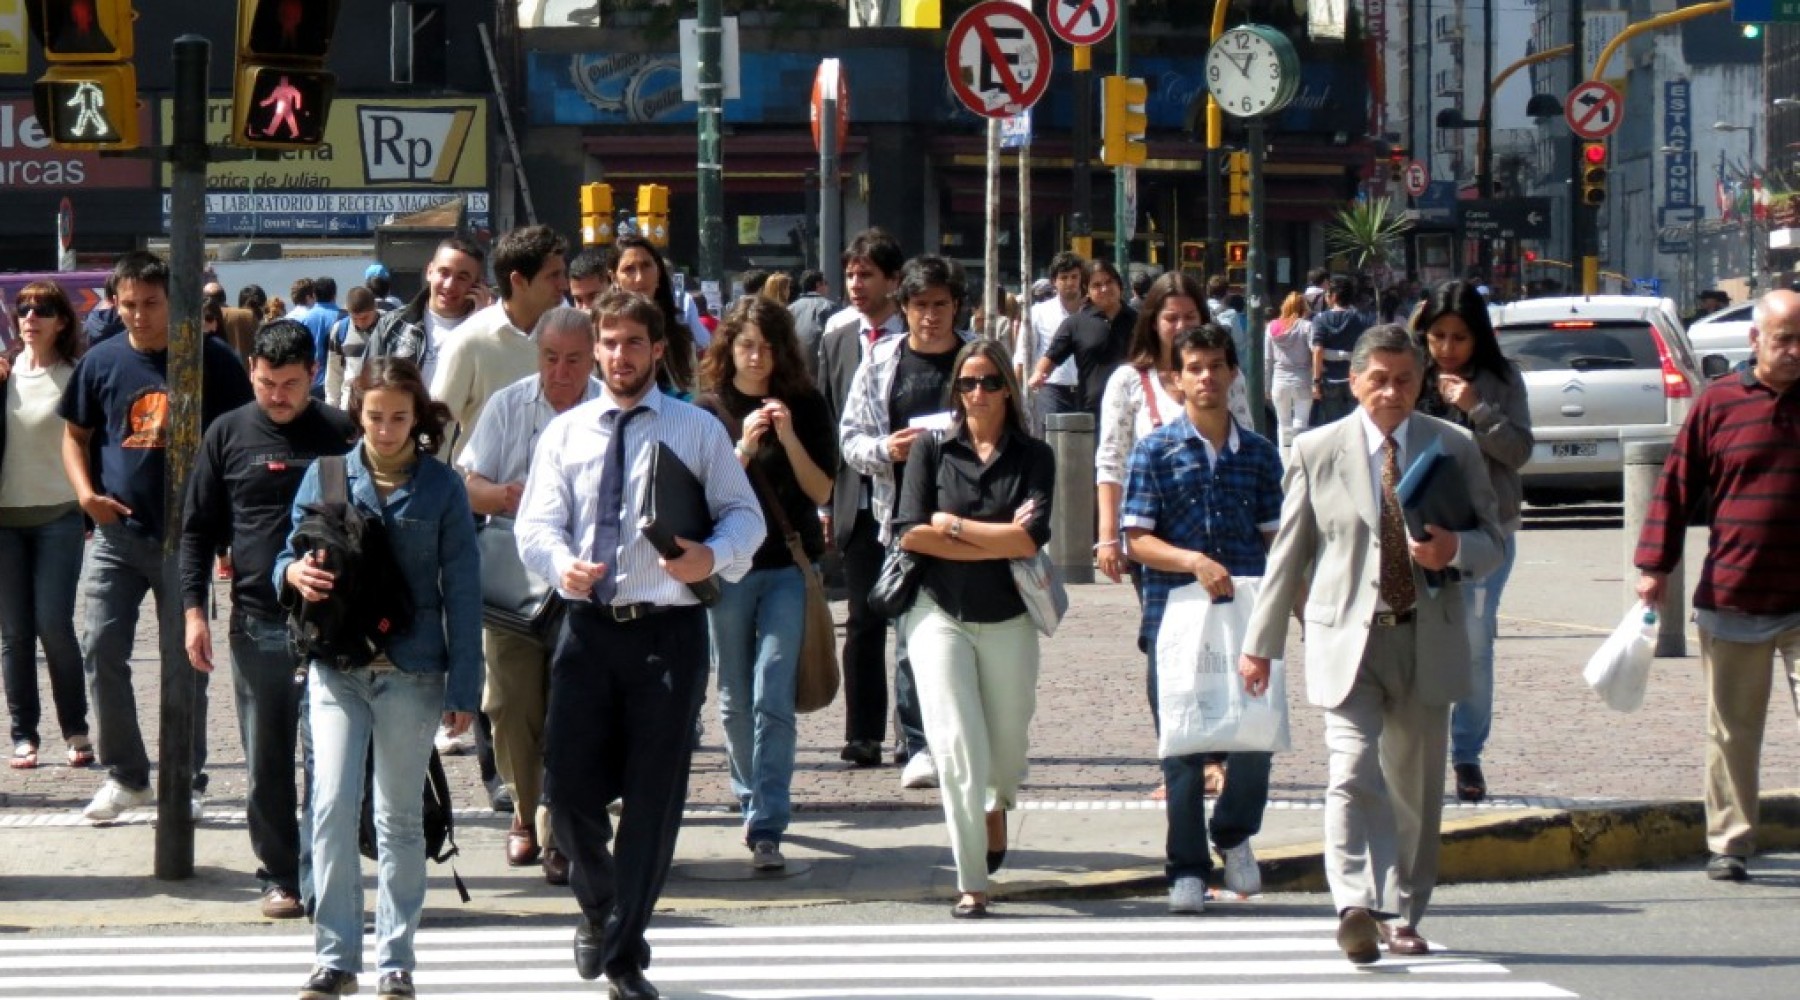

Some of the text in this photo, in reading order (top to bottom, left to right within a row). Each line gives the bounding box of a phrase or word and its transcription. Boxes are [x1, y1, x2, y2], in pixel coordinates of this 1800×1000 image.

[1235, 33, 1250, 50] 12
[980, 27, 1024, 92] E
[1210, 65, 1220, 82] 9
[1269, 63, 1280, 80] 3
[1241, 96, 1253, 113] 6
[368, 114, 434, 180] Rp
[207, 171, 332, 188] otica de Julián
[222, 195, 314, 212] LABORATORIO
[318, 195, 333, 212] DE
[338, 195, 395, 212] RECETAS
[399, 195, 488, 212] MAGISES
